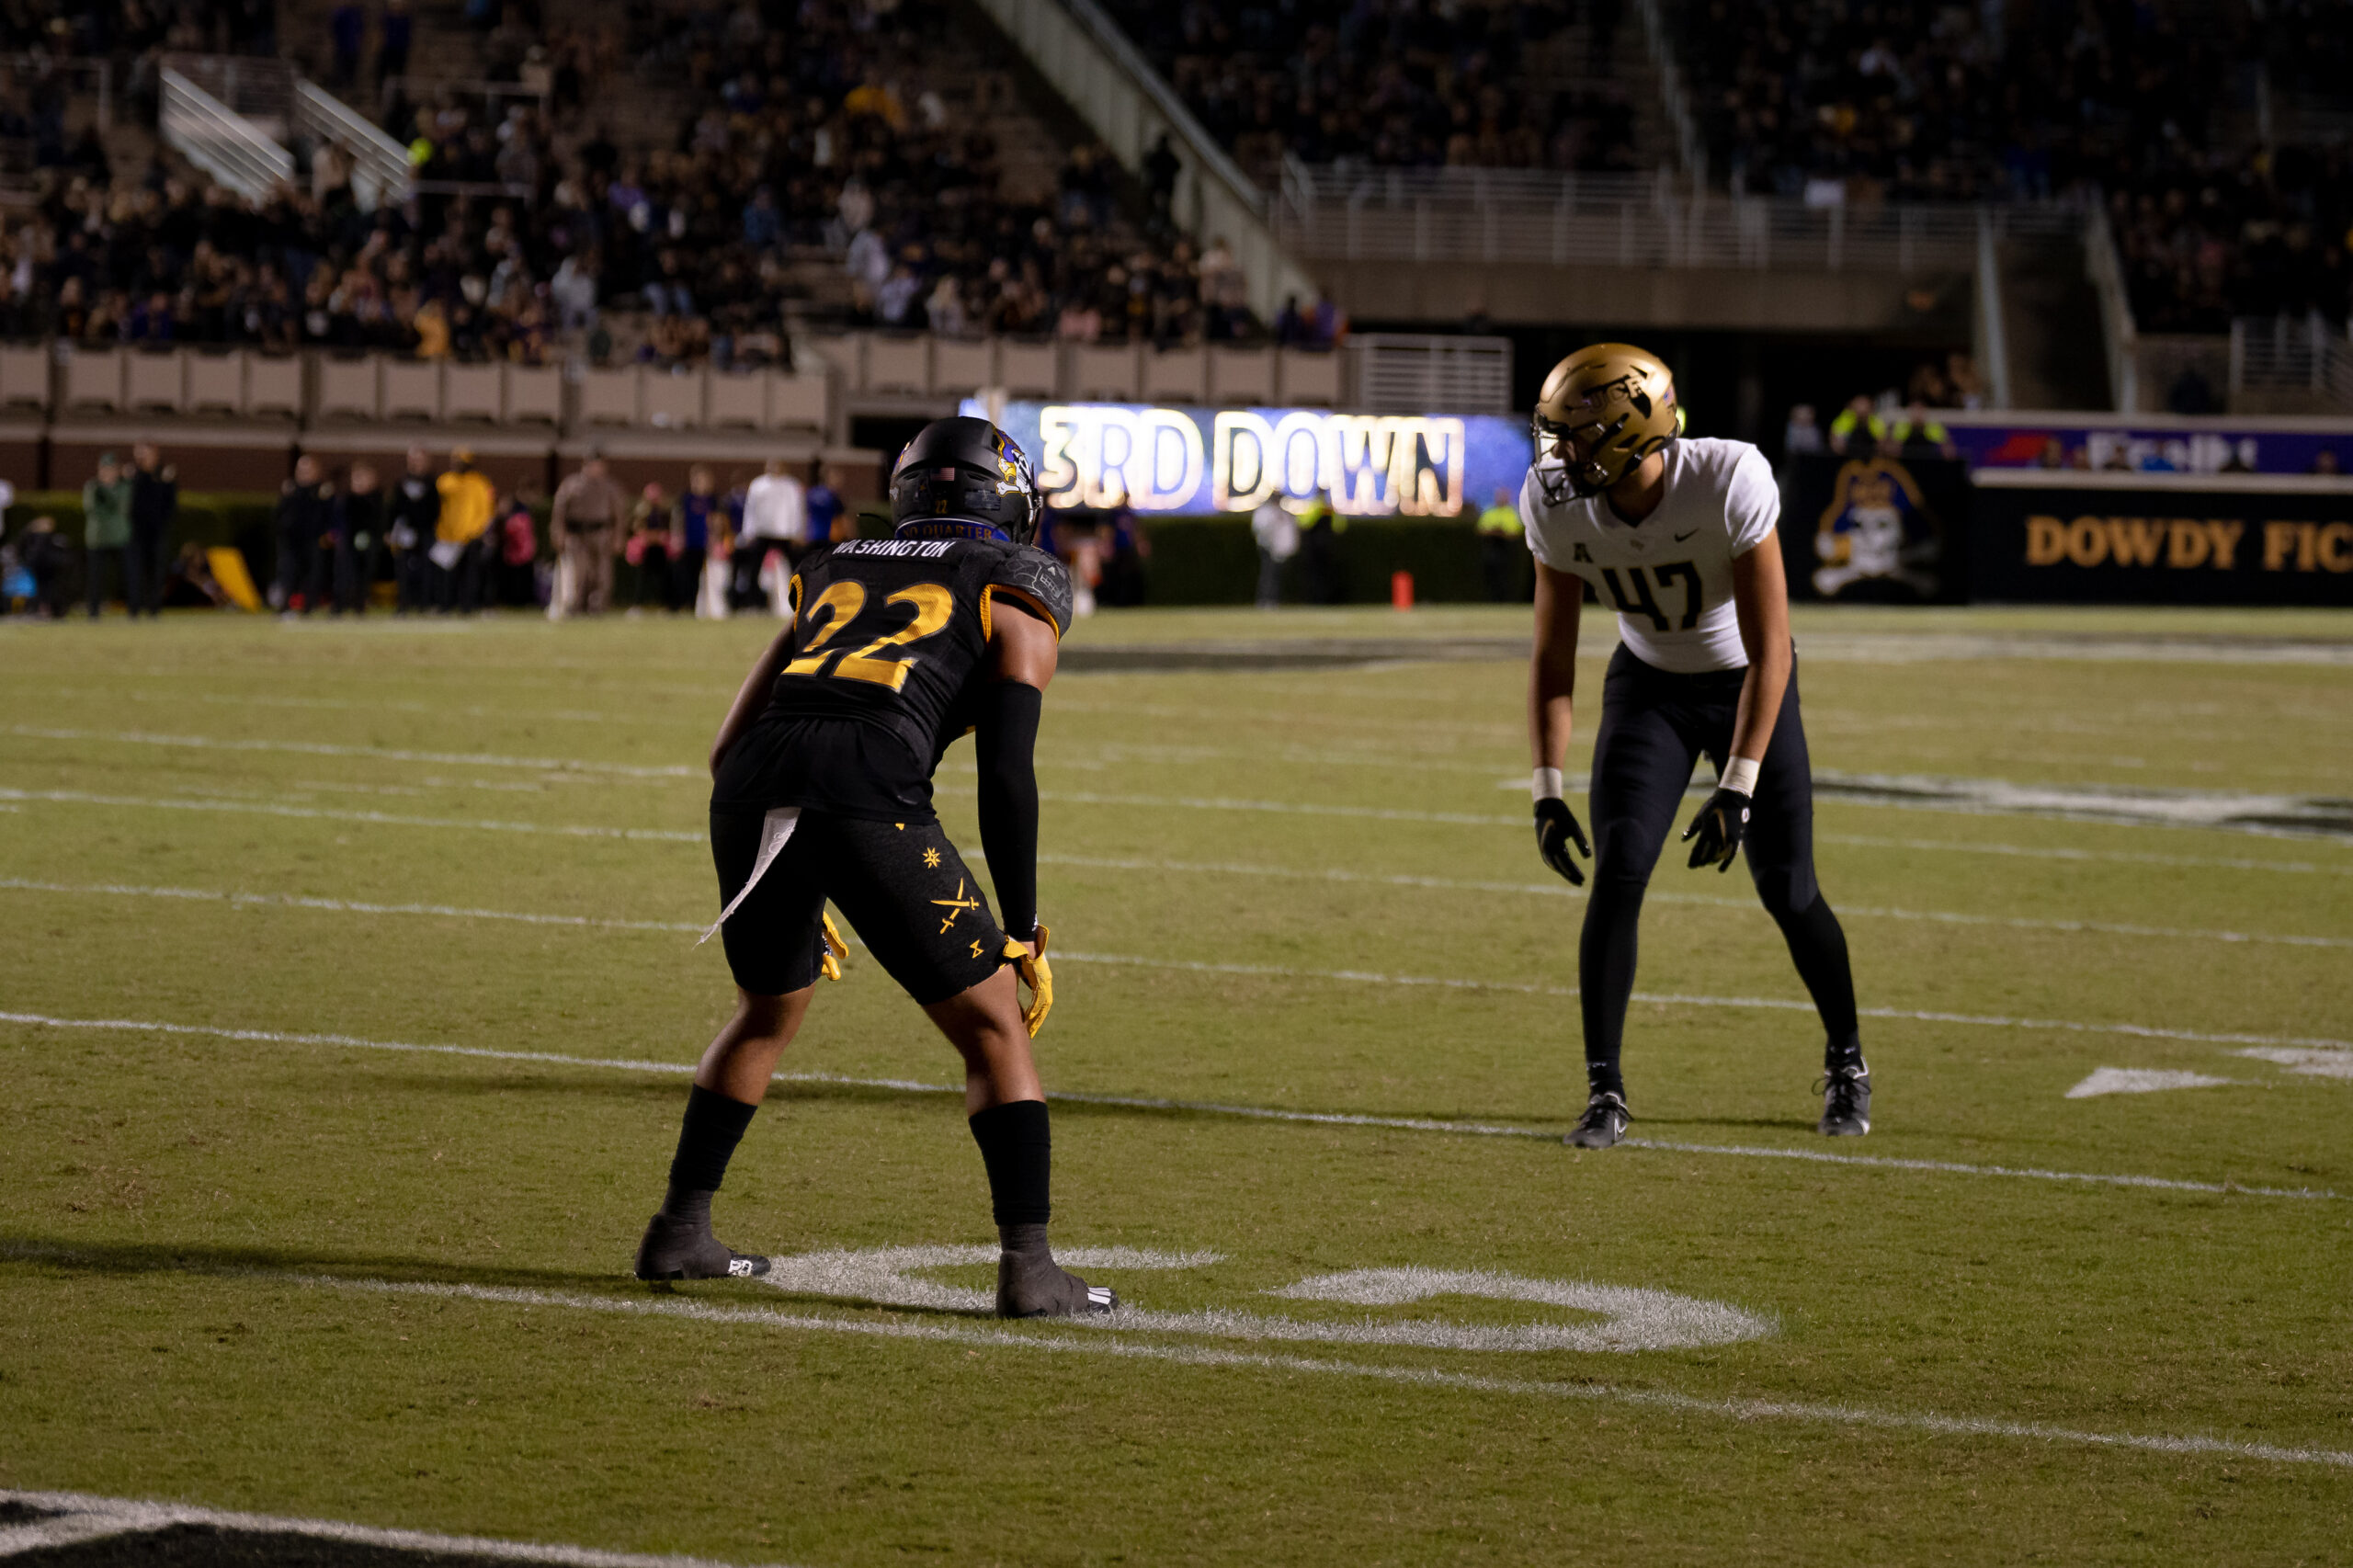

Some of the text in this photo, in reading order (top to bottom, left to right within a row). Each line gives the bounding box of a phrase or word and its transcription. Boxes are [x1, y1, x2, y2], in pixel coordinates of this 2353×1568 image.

[1039, 405, 1464, 517] 3RD DOWN
[923, 524, 992, 540] QUARTER
[935, 499, 949, 514] 22
[832, 540, 956, 558] WASHINGTON
[2025, 514, 2353, 574] DOWDY FIC
[1599, 560, 1701, 631] 47
[780, 579, 954, 692] 22
